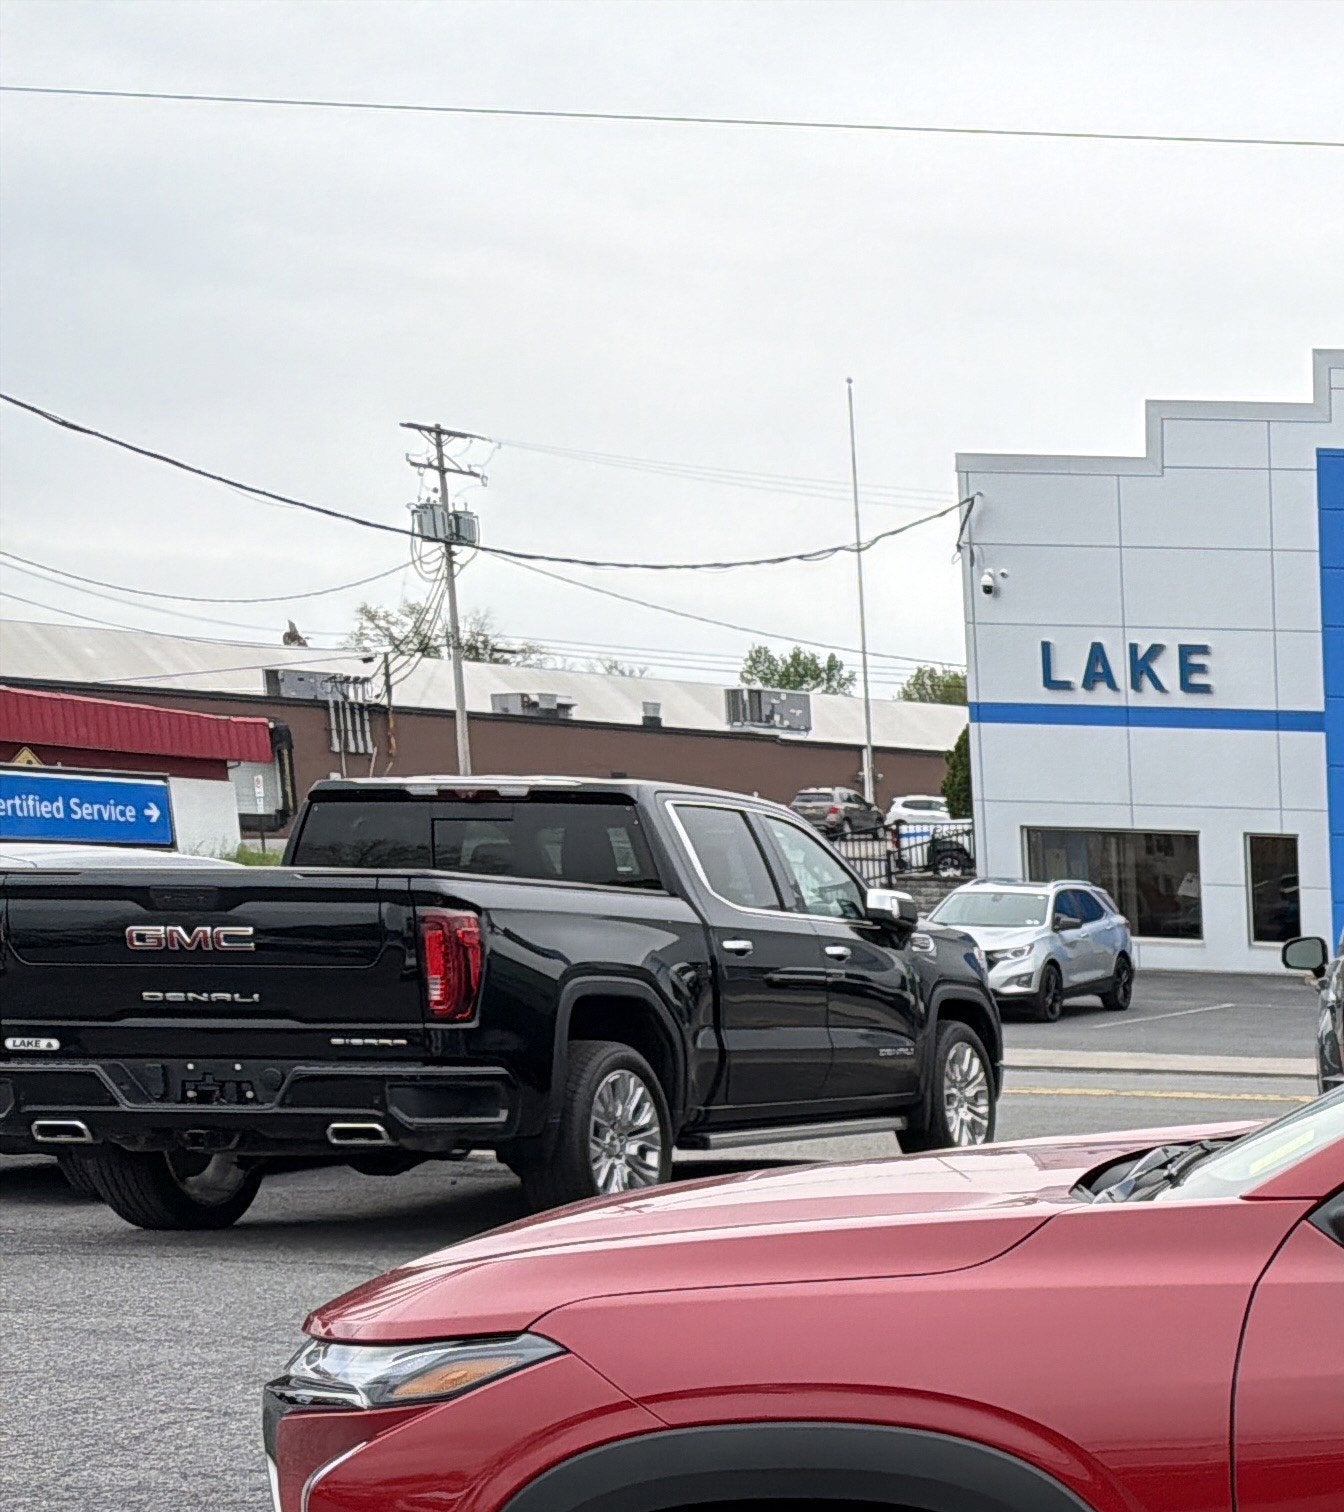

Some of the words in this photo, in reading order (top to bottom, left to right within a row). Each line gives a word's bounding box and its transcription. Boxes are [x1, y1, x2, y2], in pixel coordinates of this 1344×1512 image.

[1040, 640, 1214, 696] LAKE
[0, 794, 65, 819] ertified
[69, 797, 136, 822] Service
[125, 925, 256, 951] GMC
[142, 991, 261, 1003] DENALI
[12, 1039, 41, 1048] LAKE
